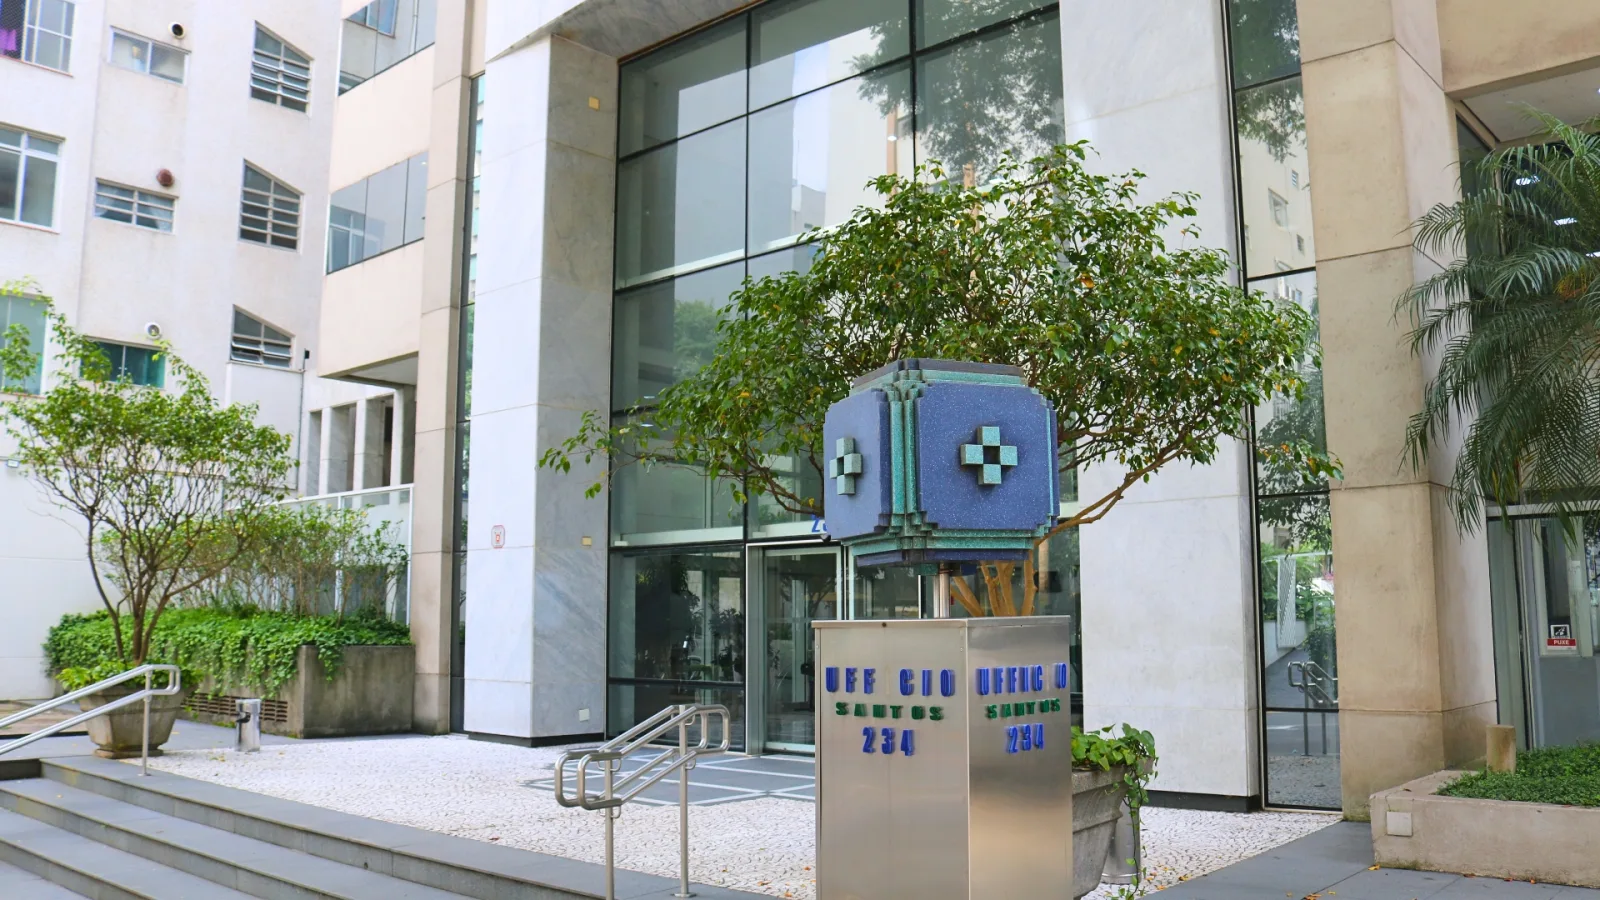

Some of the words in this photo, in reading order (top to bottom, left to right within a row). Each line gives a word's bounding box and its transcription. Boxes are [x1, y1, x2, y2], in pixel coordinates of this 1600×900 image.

[825, 666, 956, 697] UFFCIO
[975, 663, 1067, 696] UFFICO
[835, 701, 944, 721] SANTOS
[985, 698, 1061, 719] SANTOS
[862, 726, 916, 757] 234
[1005, 723, 1044, 754] 234
